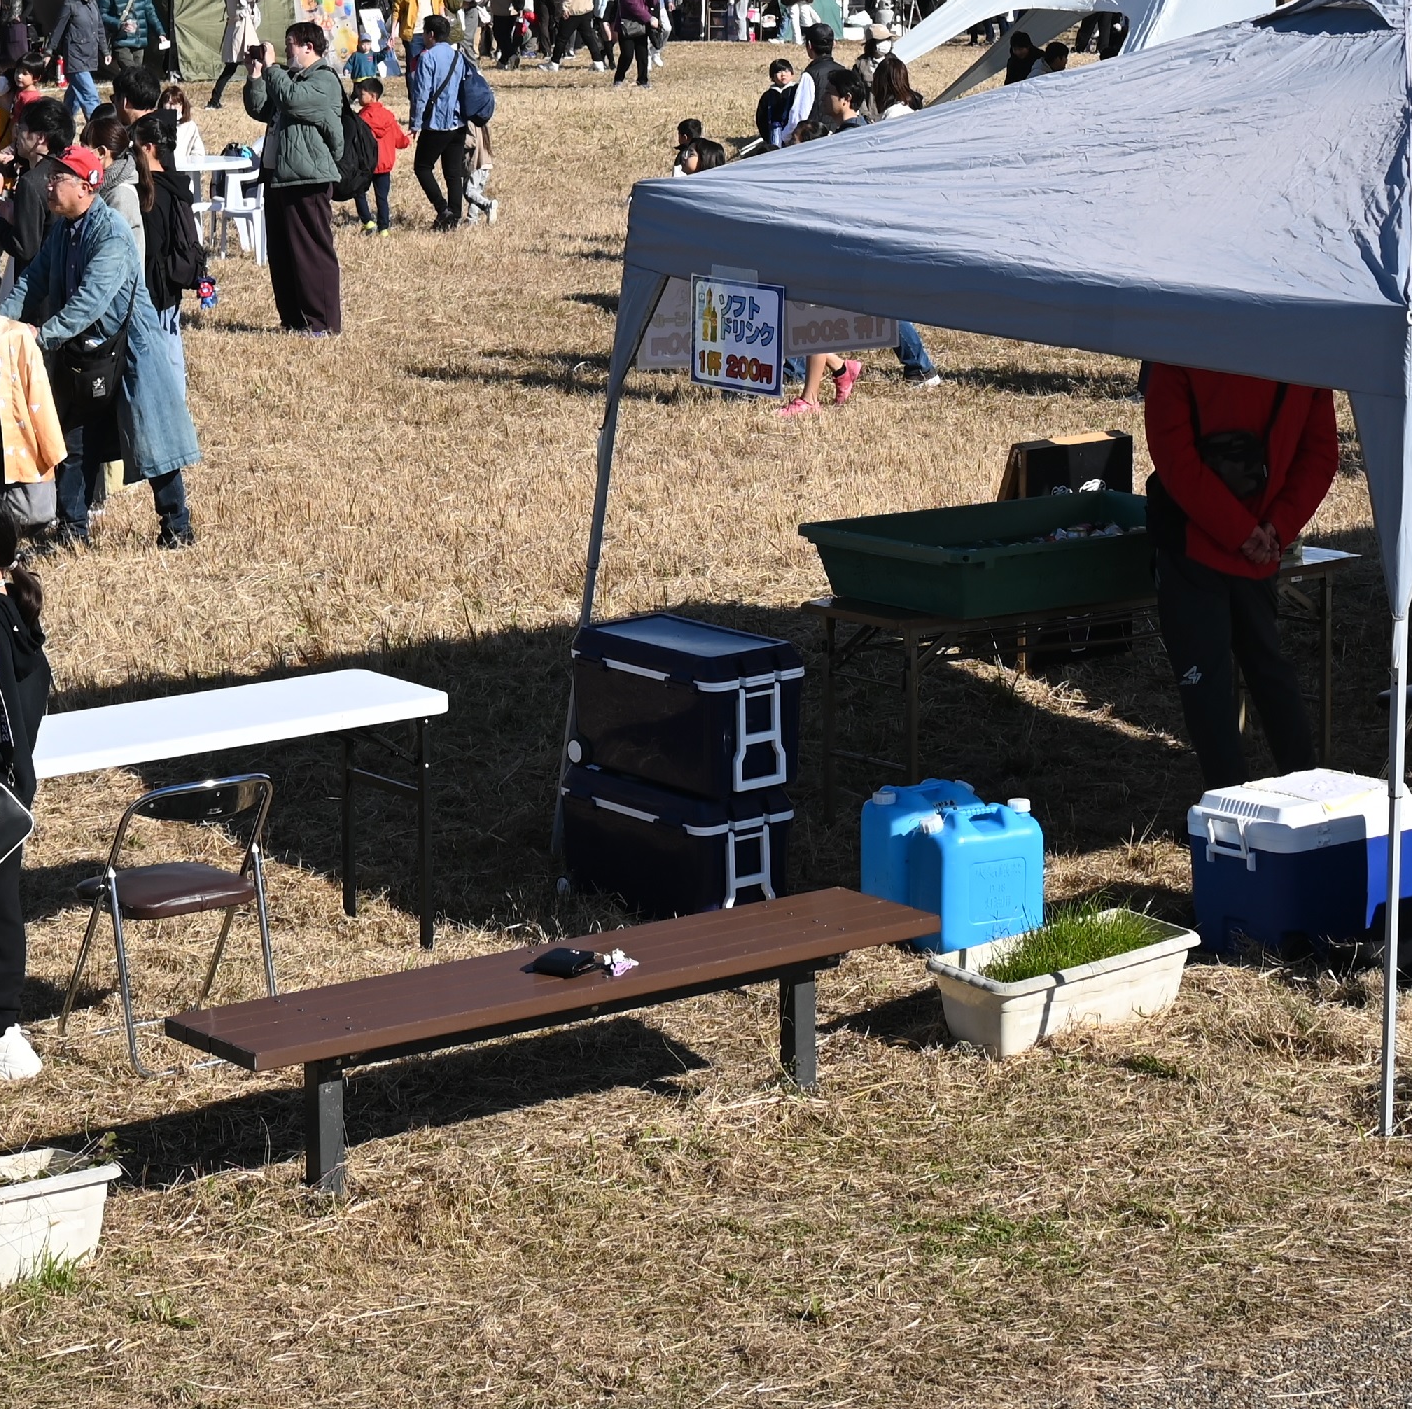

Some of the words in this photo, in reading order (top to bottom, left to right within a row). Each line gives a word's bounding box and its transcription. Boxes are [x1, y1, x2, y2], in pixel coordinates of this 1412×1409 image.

[718, 294, 760, 320] ソフト
[720, 318, 775, 347] ドリンク
[698, 350, 722, 376] 1杯
[725, 354, 773, 385] 200円
